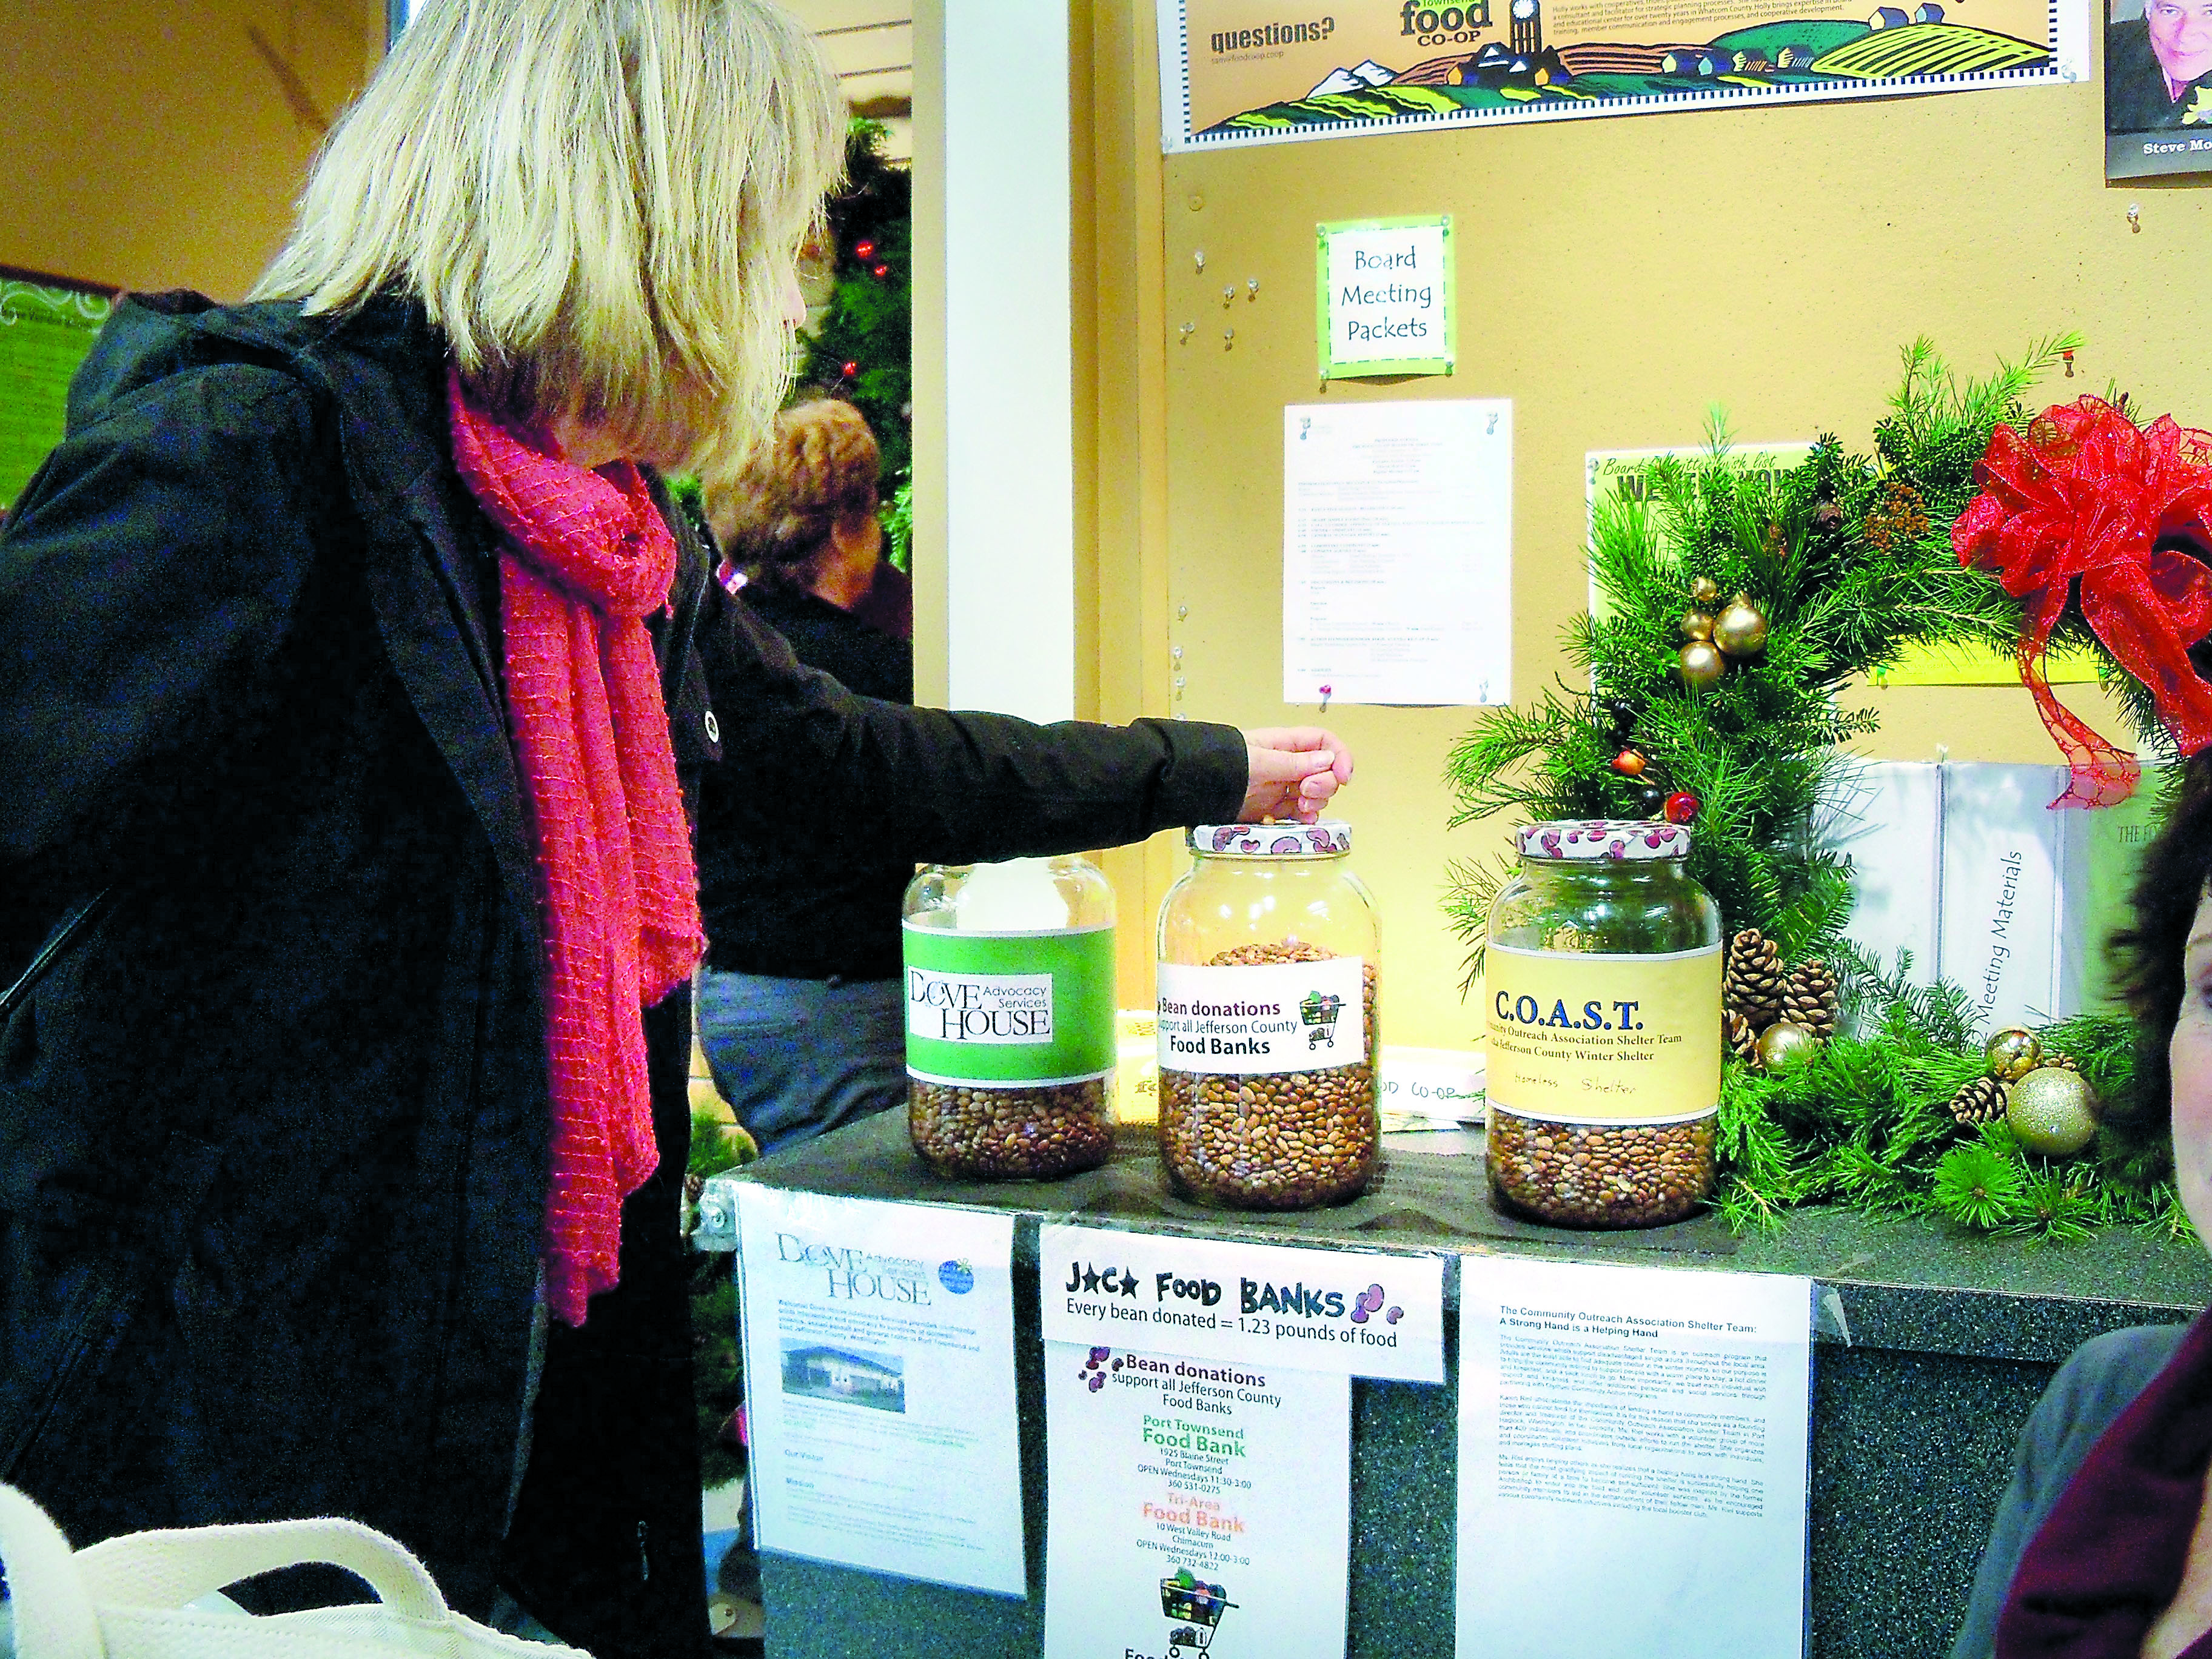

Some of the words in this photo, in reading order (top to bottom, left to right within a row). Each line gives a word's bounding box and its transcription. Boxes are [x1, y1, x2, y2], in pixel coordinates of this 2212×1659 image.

[1400, 0, 1493, 35] food
[1567, 18, 1601, 26] educational
[1794, 0, 1823, 9] expertise
[1672, 16, 1712, 25] engagement
[1761, 8, 1797, 17] cooperative
[1799, 4, 1844, 13] development.
[1211, 16, 1335, 54] questions?
[1417, 30, 1480, 46] CO-OP
[2143, 142, 2185, 154] Steve
[2189, 139, 2212, 150] Mo
[1355, 246, 1416, 270] Board
[1341, 284, 1432, 309] Meeting
[1348, 317, 1427, 341] Packets
[1603, 458, 1644, 475] Board
[1754, 452, 1777, 468] list
[2118, 826, 2140, 842] THE
[1991, 850, 2022, 939] Materials
[983, 986, 1047, 997] Advocacy
[1977, 943, 2011, 1025] Meeting
[999, 998, 1047, 1008] Services
[1162, 997, 1187, 1015] Bean
[1191, 1000, 1281, 1016] donations
[1496, 991, 1644, 1030] C.O.A.S.T.
[941, 1008, 1050, 1040] HOUSE
[1158, 1019, 1180, 1032] pport
[1182, 1019, 1192, 1033] all
[1196, 1020, 1247, 1034] Jefferson
[1252, 1020, 1297, 1034] County
[1170, 1036, 1205, 1054] Food
[1211, 1037, 1270, 1054] Banks
[1508, 1026, 1547, 1041] Outreach
[1550, 1033, 1614, 1045] Association
[1617, 1035, 1655, 1045] Shelter
[1657, 1034, 1681, 1044] Team
[1500, 1039, 1531, 1054] Jefferson
[1535, 1046, 1572, 1062] County
[1575, 1050, 1614, 1061] Winter
[1617, 1051, 1654, 1061] Shelter
[1412, 1082, 1455, 1099] CO-OP
[1515, 1072, 1558, 1088] Homeless
[1581, 1076, 1637, 1094] Shelter
[827, 1268, 931, 1305] HOUSE
[1156, 1272, 1222, 1306] FOOD
[1240, 1276, 1346, 1319] BANKS
[1066, 1298, 1107, 1319] Every
[1110, 1302, 1148, 1322] bean
[1153, 1306, 1216, 1329] donated
[1220, 1320, 1233, 1329] =
[1238, 1318, 1270, 1335] 1.23
[1275, 1321, 1335, 1344] pounds
[1339, 1327, 1358, 1344] of
[1360, 1328, 1397, 1348] food
[1500, 1305, 1517, 1315] The
[1520, 1307, 1575, 1321] Community
[1578, 1312, 1623, 1323] Outreach
[1626, 1316, 1684, 1328] Association
[1688, 1320, 1723, 1331] Shelter
[1726, 1322, 1757, 1333] Team:
[1510, 1318, 1541, 1330] Strong
[1544, 1321, 1569, 1330] Hand
[1592, 1324, 1629, 1338] Helping
[1632, 1328, 1658, 1338] Hand
[1126, 1354, 1170, 1376] Bean
[1175, 1361, 1265, 1387] donations
[1111, 1373, 1159, 1392] support
[1162, 1377, 1176, 1391] all
[1178, 1380, 1234, 1400] Jefferson
[1237, 1388, 1281, 1409] County
[1162, 1394, 1193, 1409] Food
[1196, 1399, 1232, 1415] Banks
[1144, 1415, 1171, 1429] Port
[1173, 1419, 1244, 1440] Townsend
[1142, 1427, 1191, 1449] Food
[1196, 1436, 1247, 1457] Bank
[1160, 1447, 1178, 1457] 1925
[1206, 1455, 1229, 1465] Street
[1165, 1458, 1181, 1467] Port
[1184, 1461, 1222, 1475] Townsend
[1138, 1464, 1159, 1475] OPEN
[1161, 1467, 1208, 1483] Wednesdays
[1168, 1480, 1182, 1488] 360
[1184, 1481, 1220, 1494] 531-0275
[1167, 1492, 1221, 1511] Tri-Area
[1144, 1502, 1190, 1524] Food
[1196, 1511, 1244, 1533] Bank
[1156, 1522, 1165, 1530] 10
[1166, 1523, 1185, 1534] West
[1187, 1527, 1209, 1539] Valley
[1212, 1531, 1231, 1541] Road
[1172, 1535, 1213, 1549] Chimacum
[1136, 1539, 1157, 1550] OPEN
[1159, 1543, 1206, 1559] Wednesdays
[1166, 1555, 1181, 1564] 360
